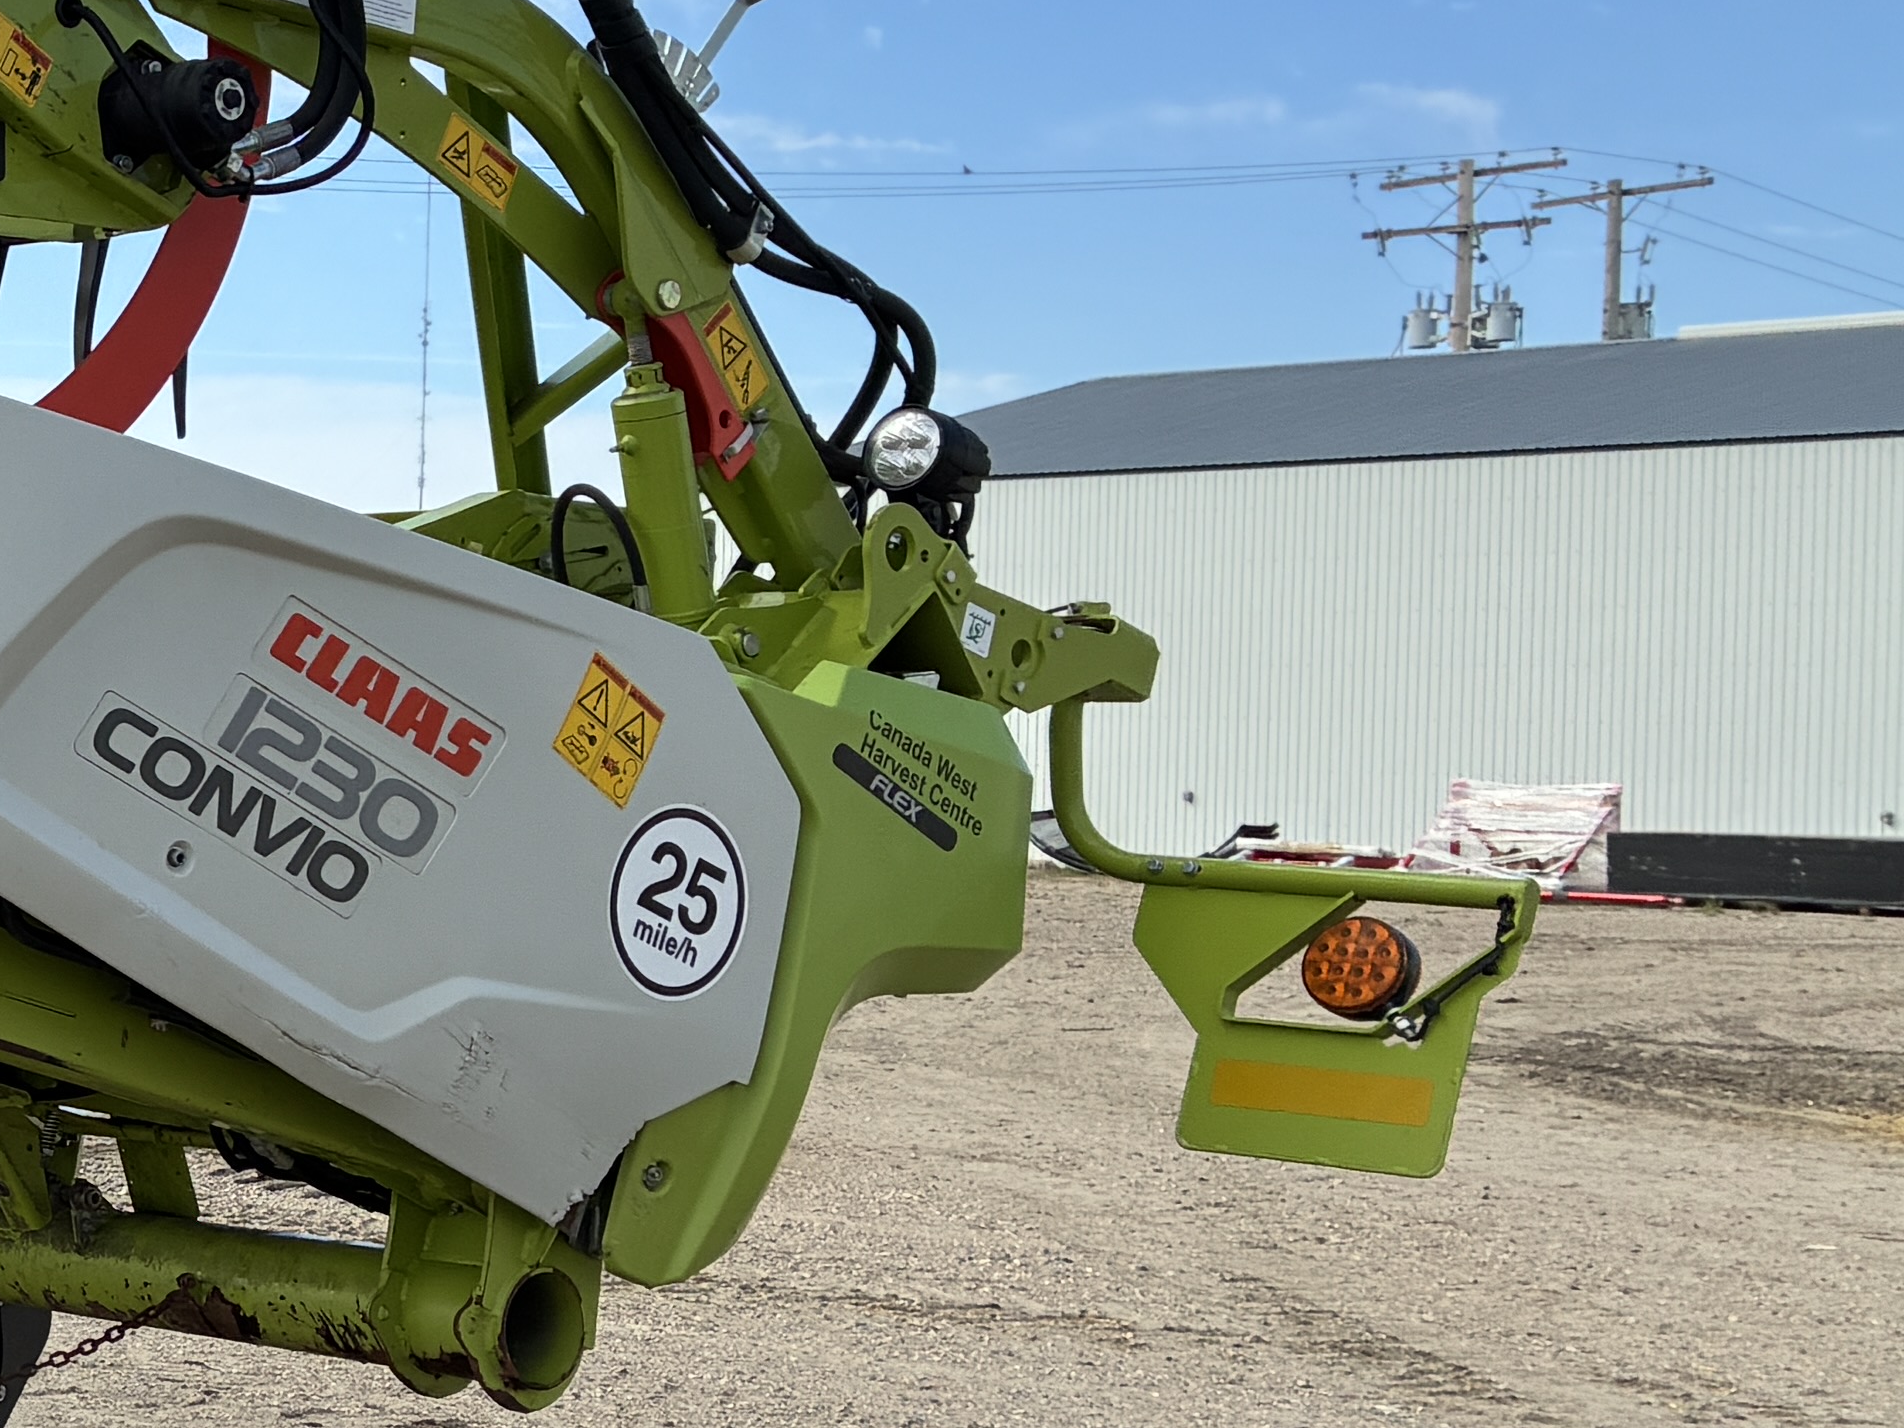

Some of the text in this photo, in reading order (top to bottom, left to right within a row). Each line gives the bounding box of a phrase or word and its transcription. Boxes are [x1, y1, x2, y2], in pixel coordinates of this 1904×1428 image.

[270, 612, 492, 777] CLAAS
[217, 686, 439, 858] 1230
[860, 732, 983, 836] Harvest Centre
[869, 709, 978, 801] Canada West
[869, 773, 923, 823] FLEX
[93, 707, 370, 903] CONVIO
[636, 841, 727, 935] 25
[632, 918, 698, 968] mile/h
